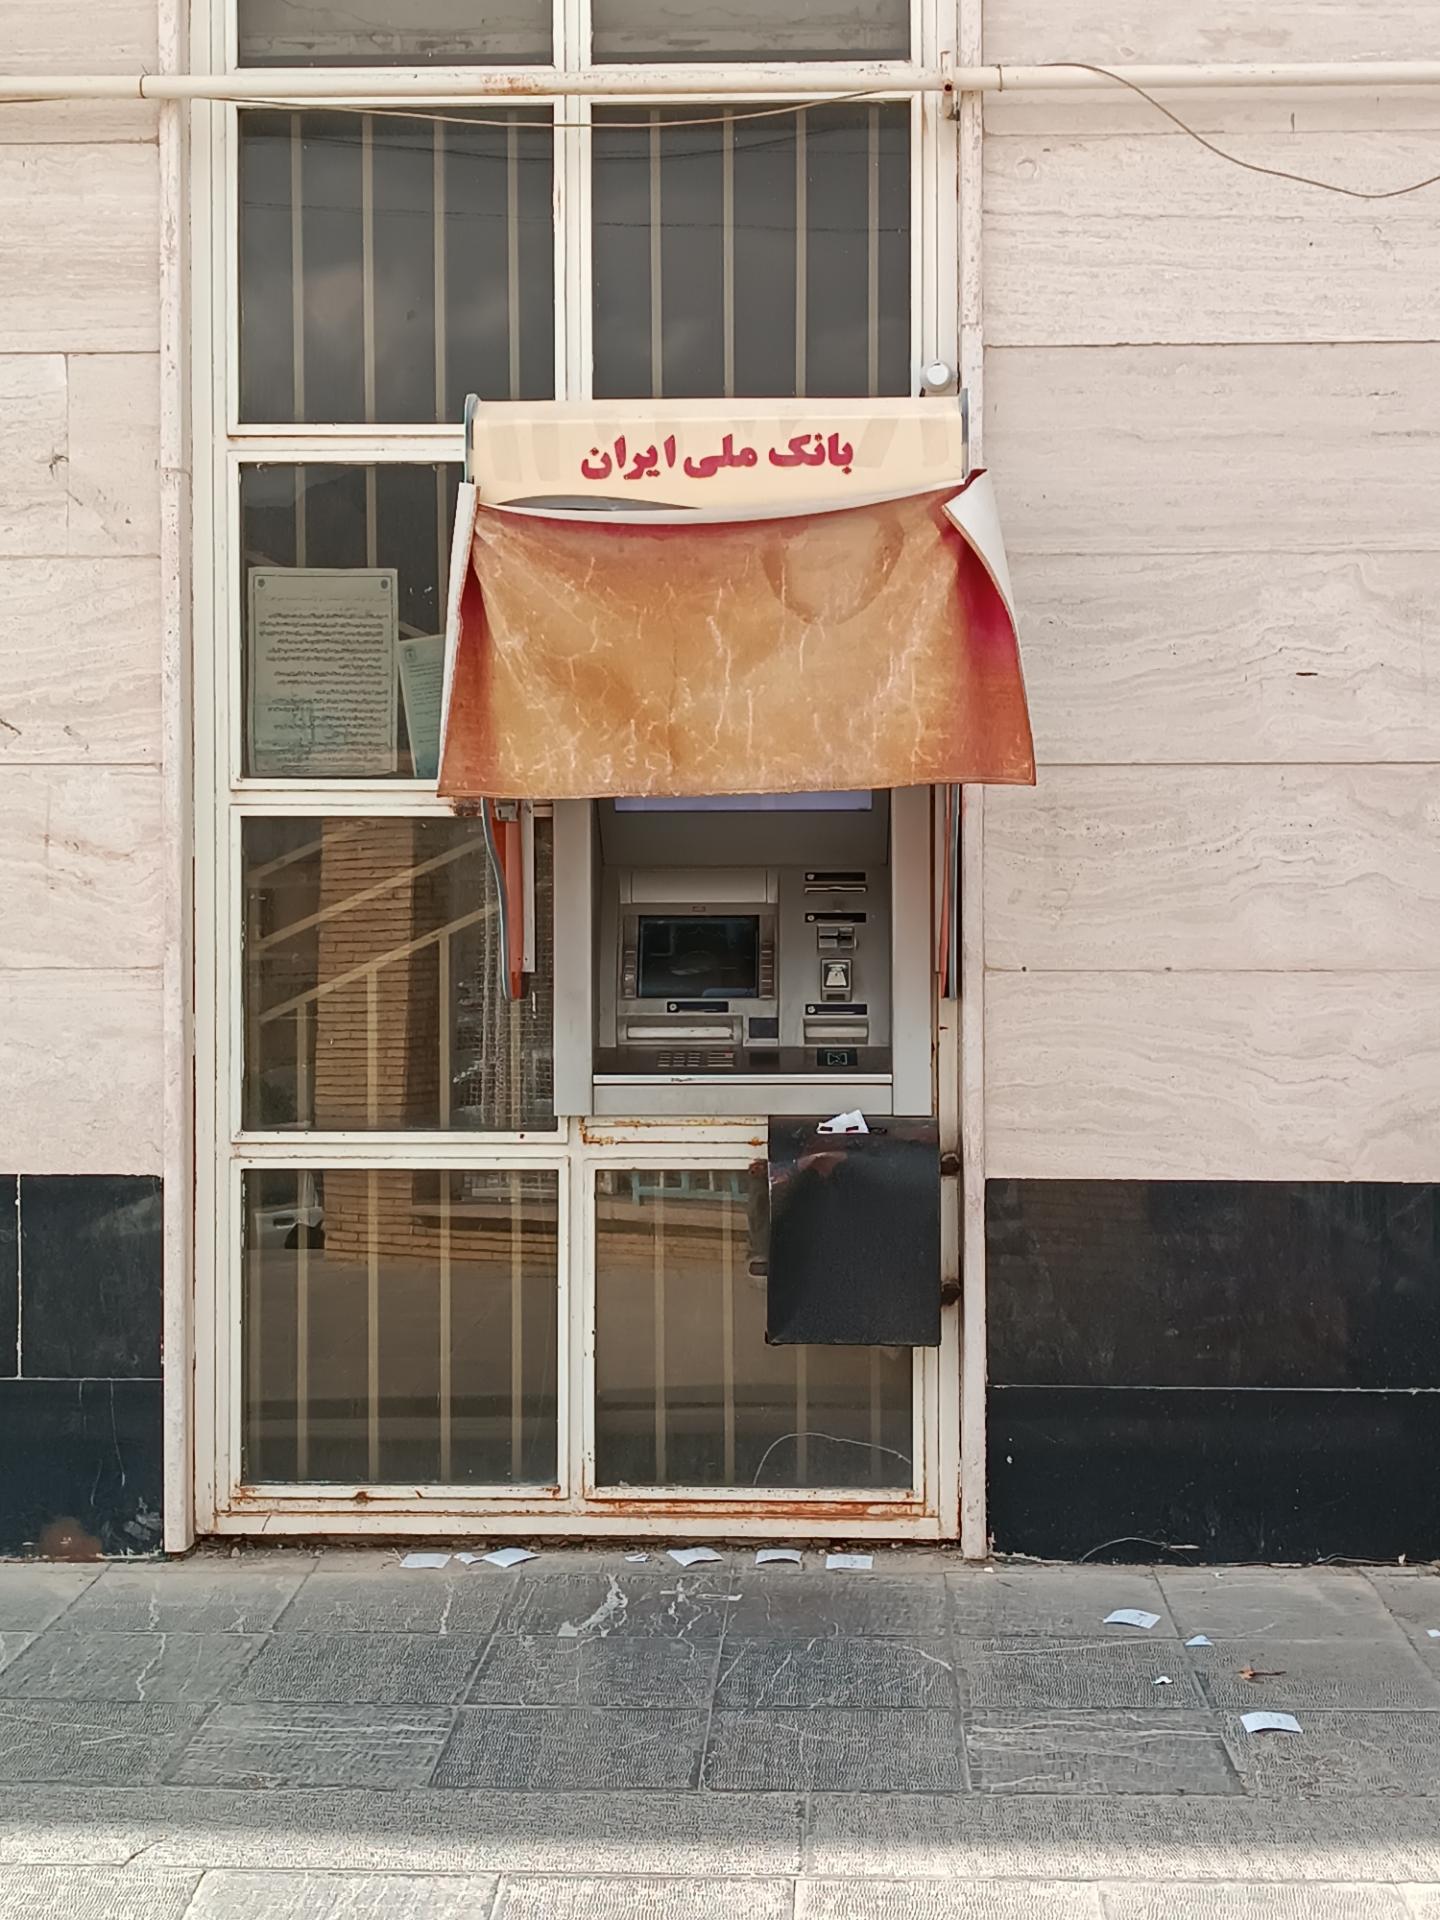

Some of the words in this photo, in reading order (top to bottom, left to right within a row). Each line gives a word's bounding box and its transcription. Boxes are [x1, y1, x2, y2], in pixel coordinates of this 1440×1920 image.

[581, 435, 676, 480] ایران
[683, 434, 757, 478] ملی
[768, 433, 853, 475] بانک
